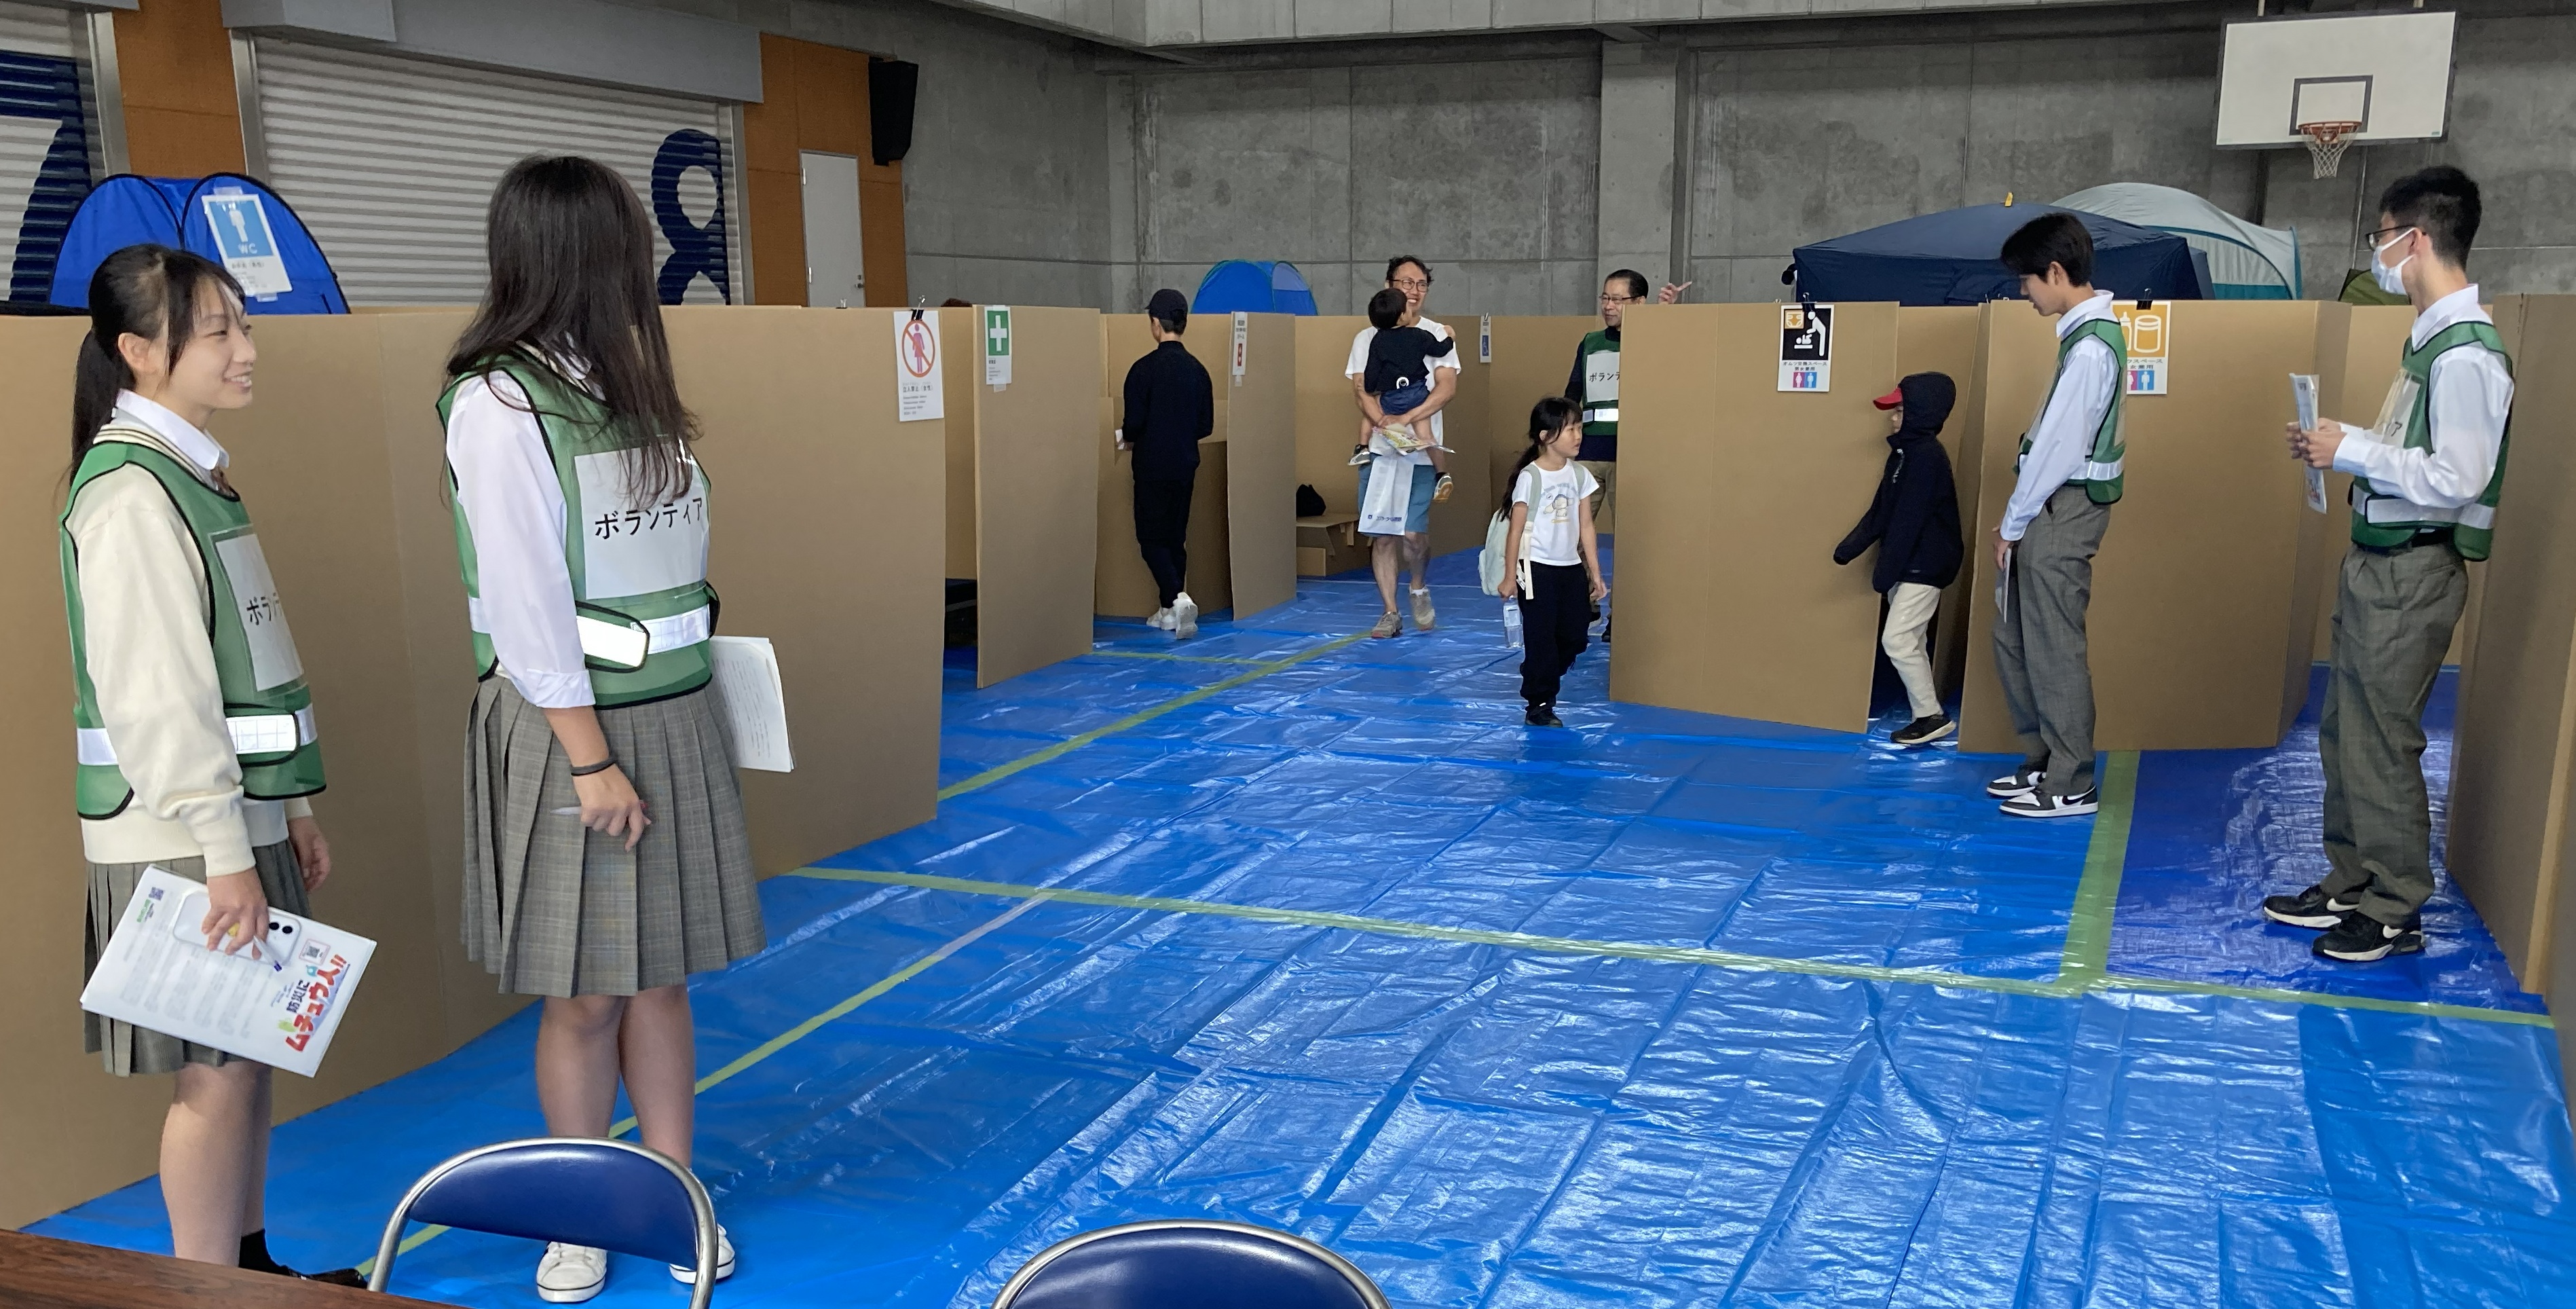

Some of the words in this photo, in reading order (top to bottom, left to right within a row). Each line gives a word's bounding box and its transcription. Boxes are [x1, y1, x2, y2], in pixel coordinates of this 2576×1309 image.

[238, 243, 257, 254] WC
[595, 497, 702, 540] ボランティア
[286, 979, 311, 1013] 防災に
